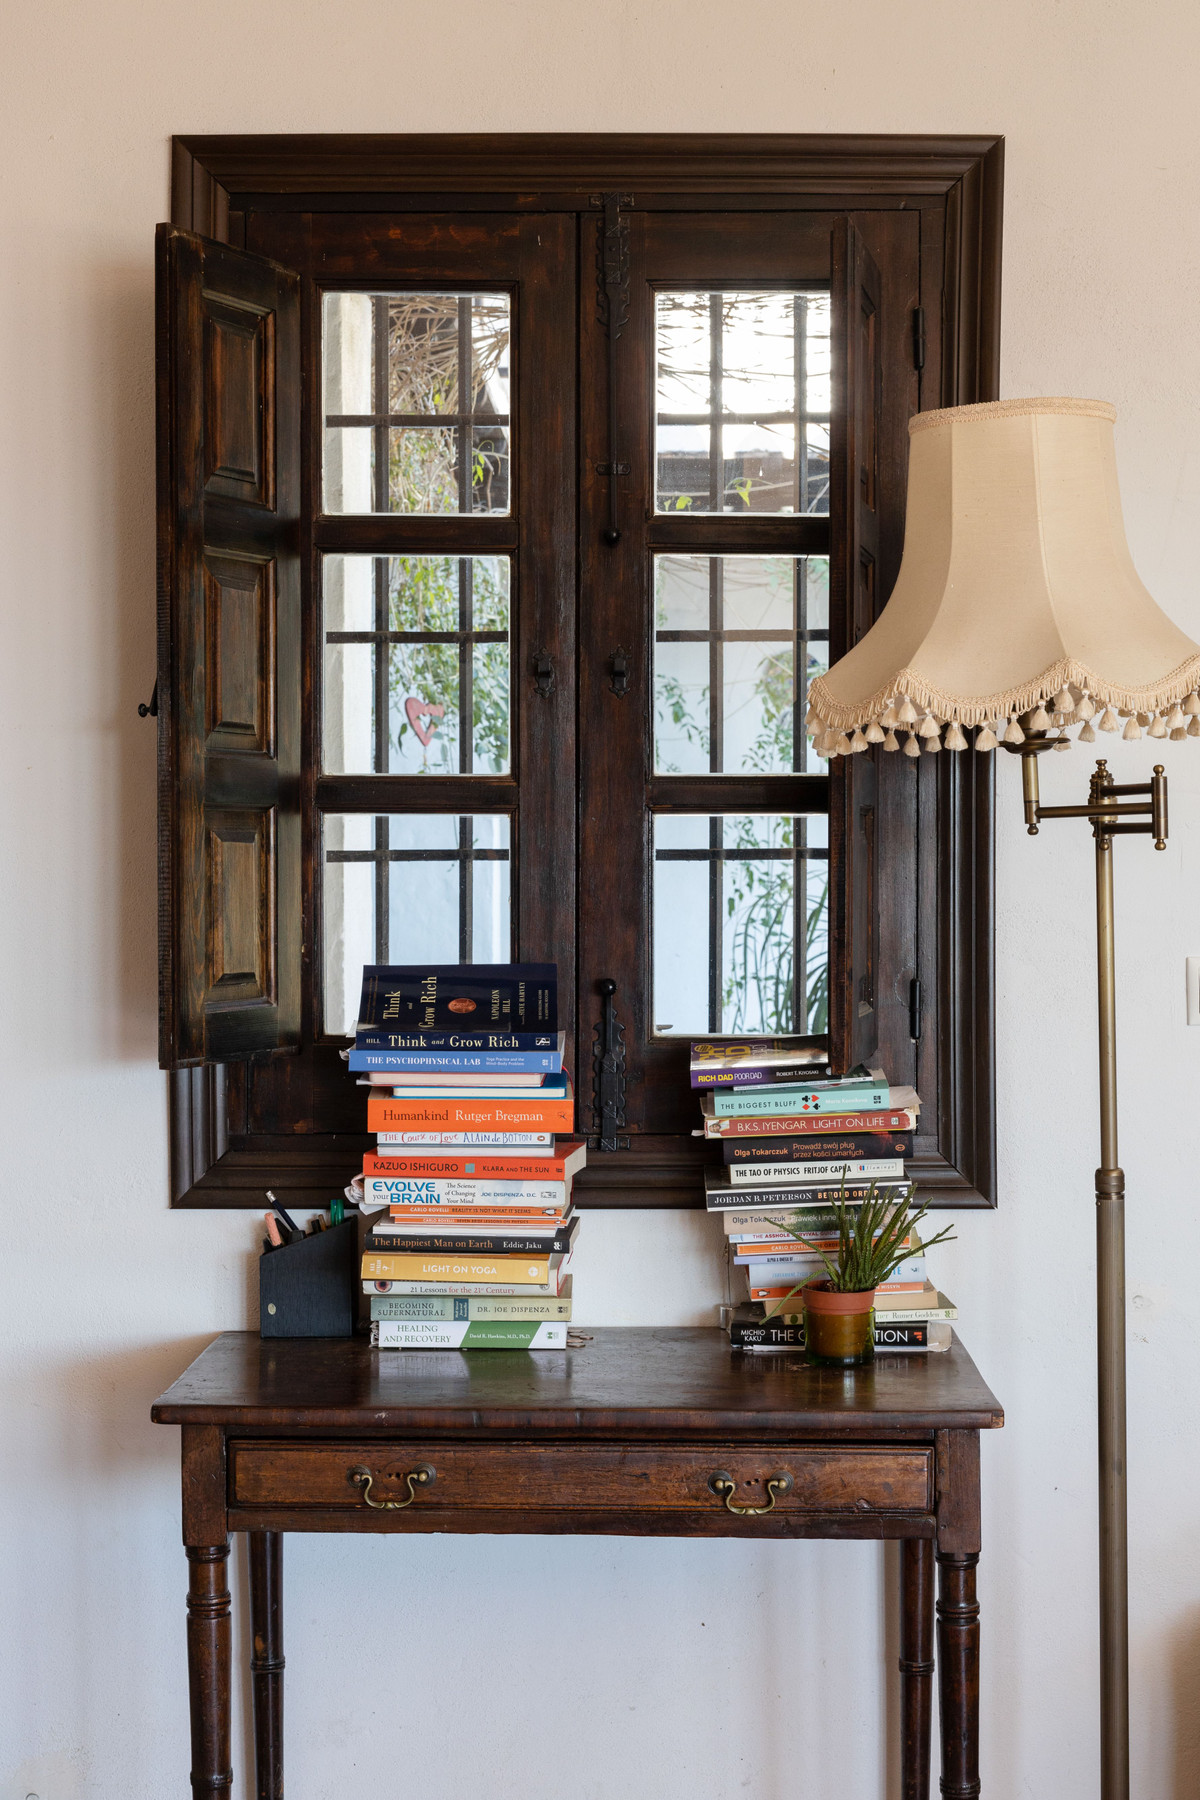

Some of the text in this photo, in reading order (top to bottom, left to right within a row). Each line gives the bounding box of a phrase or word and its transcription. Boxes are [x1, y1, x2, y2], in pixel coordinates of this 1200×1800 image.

[383, 991, 400, 1019] Think
[418, 976, 437, 1028] Grow Rich
[491, 990, 499, 1020] NAPOLEON
[502, 999, 510, 1012] HILL
[388, 1035, 427, 1047] Think
[449, 1035, 483, 1047] Grow
[488, 1035, 519, 1047] Rich
[366, 1056, 481, 1066] THE PSYCHOPHYSICAL LAB
[750, 1072, 763, 1080] DAD
[383, 1109, 544, 1123] Humankind Rutger Bregman
[737, 1117, 884, 1132] B.K.S. IYENGAR LIGHT ON LIFE
[382, 1133, 399, 1141] THE
[440, 1132, 459, 1144] Love
[463, 1132, 490, 1143] ALAIN
[491, 1133, 500, 1142] de
[502, 1132, 532, 1144] BOTTON
[823, 1142, 839, 1150] swój
[839, 1141, 855, 1150] pług
[734, 1147, 789, 1158] Olga Tokarczuk
[831, 1149, 864, 1157] umarłych
[373, 1161, 408, 1170] KAZUO
[409, 1162, 459, 1172] ISHIGURO
[735, 1169, 747, 1177] THE
[749, 1168, 762, 1176] TAO
[763, 1168, 772, 1176] OF
[773, 1167, 800, 1175] PHYSICS
[803, 1166, 828, 1174] FRITJOF
[372, 1181, 436, 1192] EVOLVE
[372, 1192, 440, 1204] your BRAIN
[714, 1195, 752, 1204] JORDAN
[763, 1193, 812, 1201] PETERSON
[732, 1216, 749, 1224] Olga
[750, 1215, 786, 1223] Tokaczuk
[372, 1237, 390, 1246] The
[393, 1237, 431, 1248] Happiest
[433, 1238, 453, 1247] Man
[468, 1239, 493, 1248] Earth
[503, 1241, 524, 1249] Eddie
[525, 1241, 542, 1249] Jaku
[422, 1264, 497, 1274] LIGHT ON YOGA
[397, 1324, 438, 1332] HEALING
[383, 1335, 451, 1343] AND RECOVERY
[770, 1329, 794, 1342] THE
